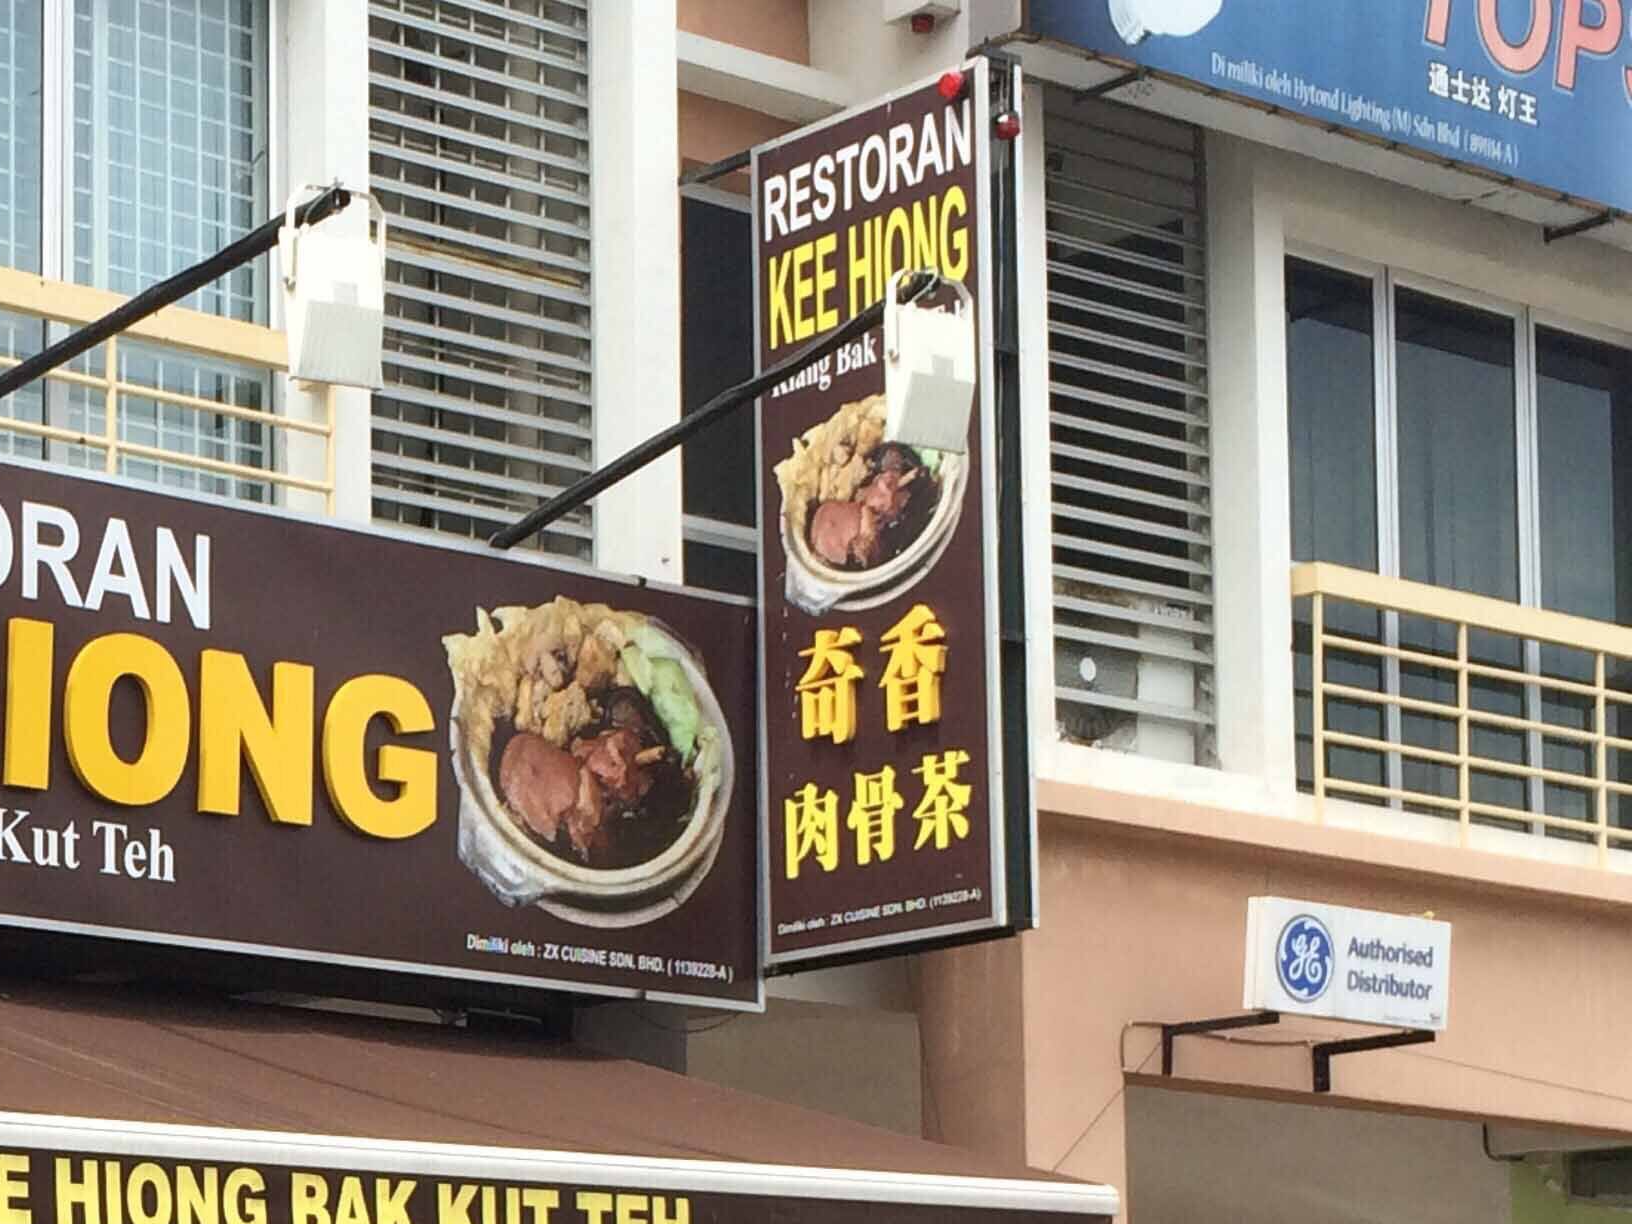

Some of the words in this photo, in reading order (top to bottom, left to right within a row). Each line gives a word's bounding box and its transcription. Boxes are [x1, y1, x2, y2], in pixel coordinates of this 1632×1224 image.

[764, 99, 971, 242] RESTORAN
[769, 232, 838, 350] KEE
[848, 185, 969, 320] HIONG
[836, 332, 877, 376] Bak
[795, 603, 952, 745] 奇香
[784, 750, 972, 881] 肉骨茶
[92, 820, 177, 883] Teh
[561, 945, 608, 966] CUISINE
[1347, 936, 1434, 969] Authorised
[1347, 970, 1433, 1001] Distributor
